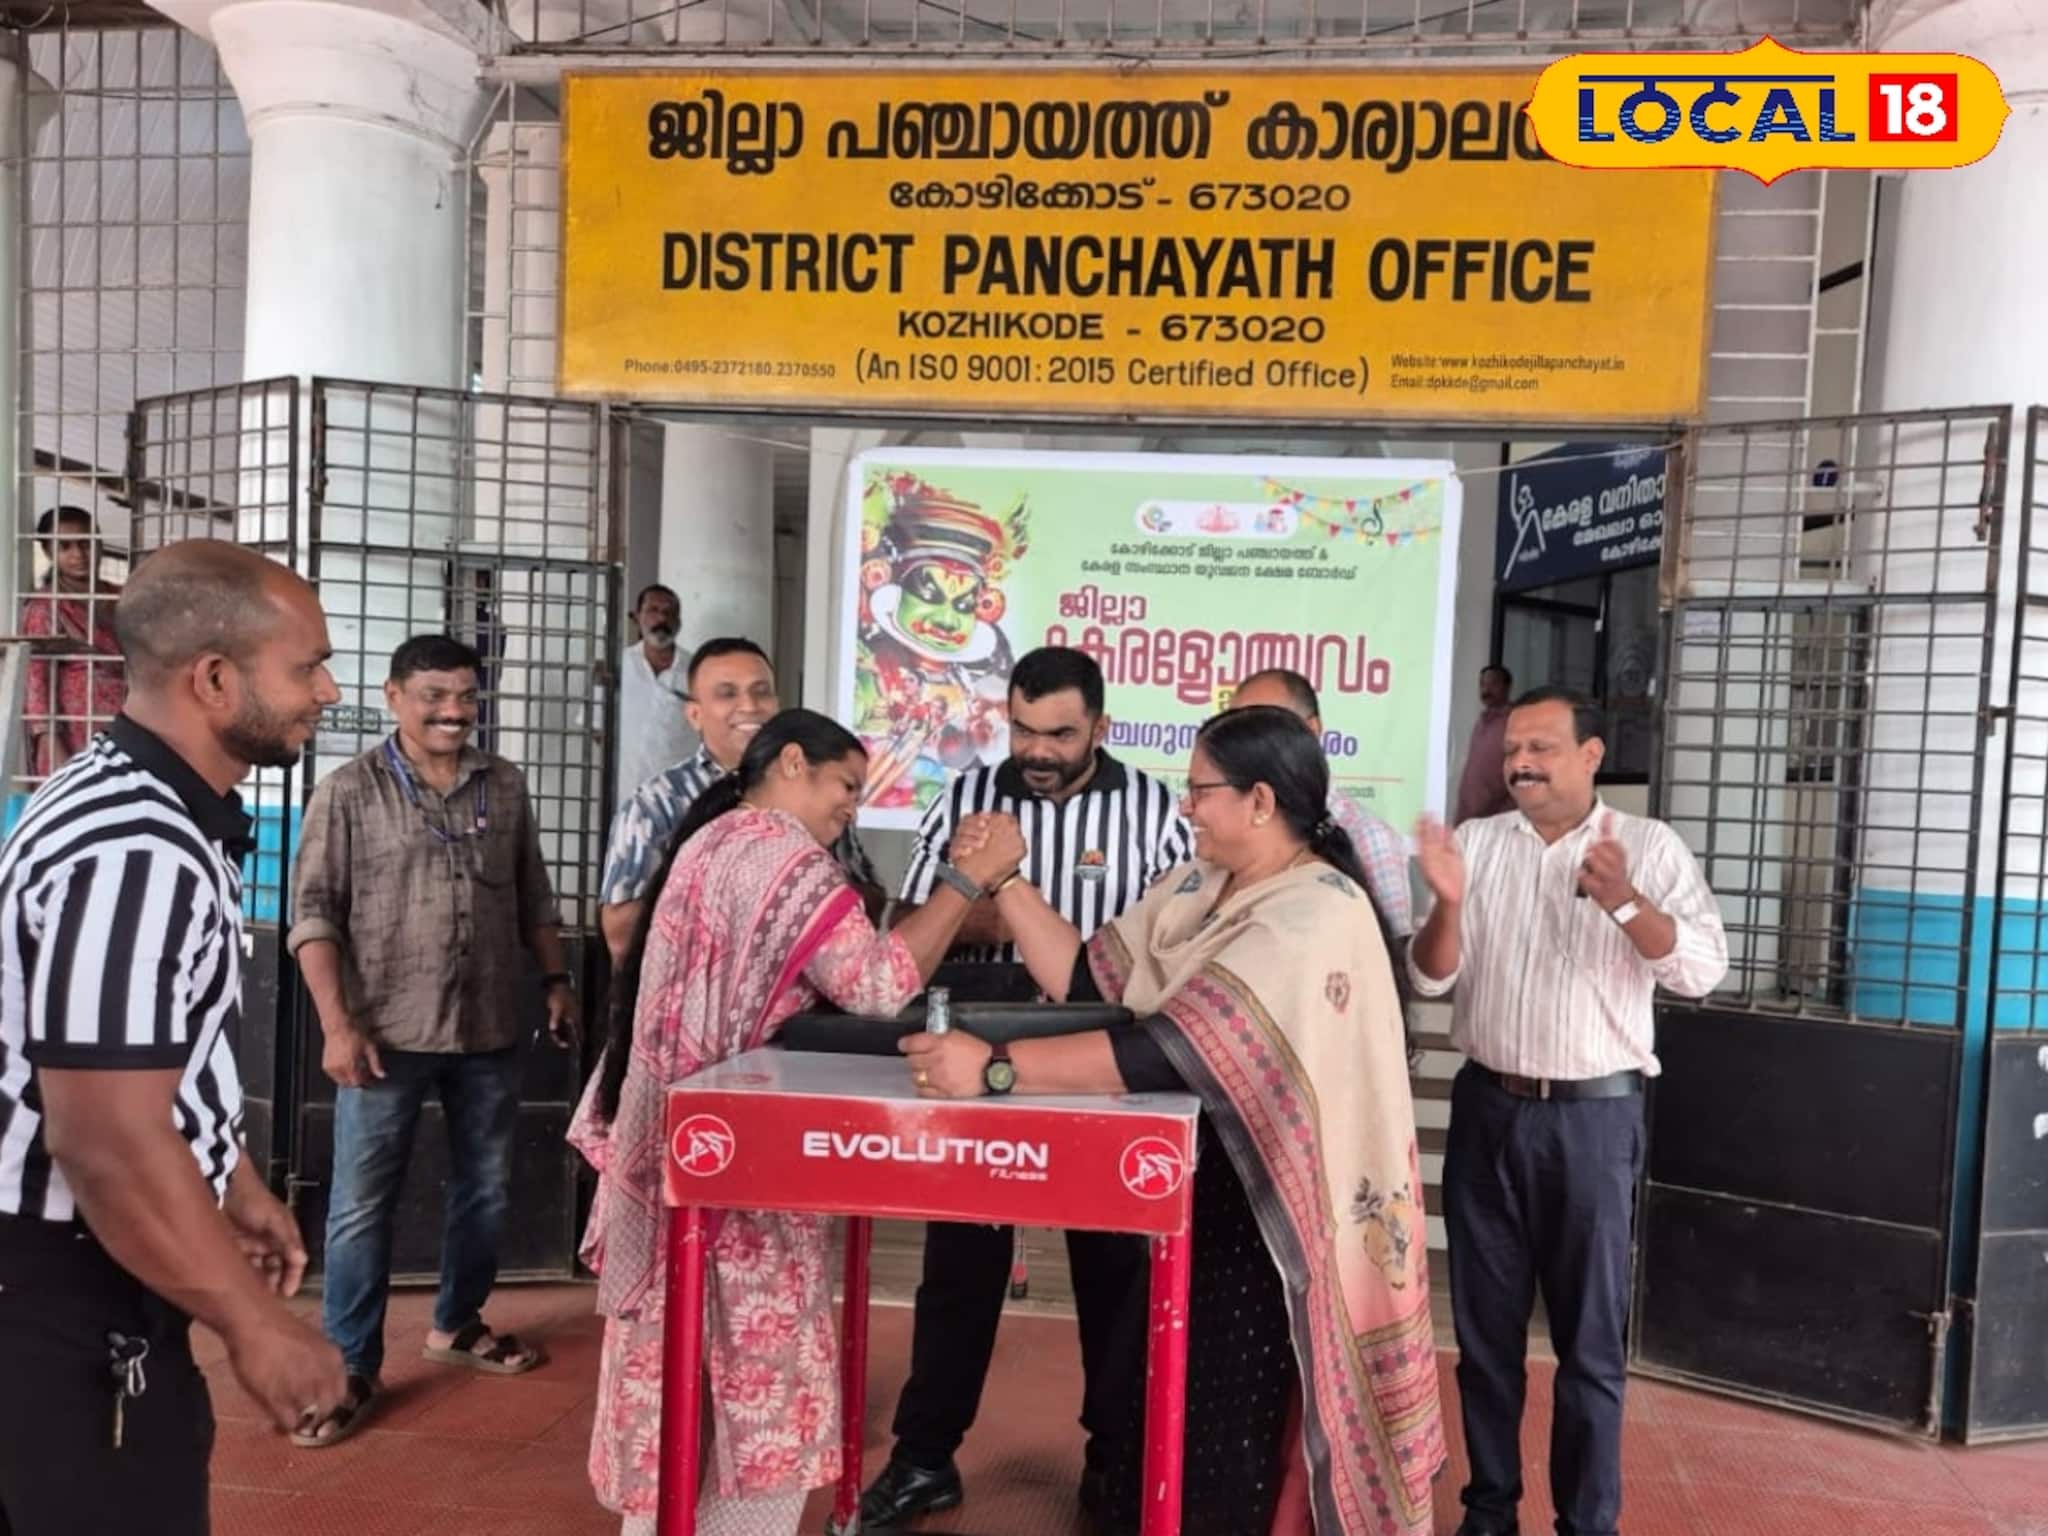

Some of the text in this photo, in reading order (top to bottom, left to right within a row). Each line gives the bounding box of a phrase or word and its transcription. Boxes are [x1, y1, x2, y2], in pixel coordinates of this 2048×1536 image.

[648, 89, 1558, 175] ജില്ലാ പഞ്ചായത്ത് കാര്യാല
[889, 174, 1155, 210] കോഴിക്കോട്
[1189, 182, 1351, 212] 673020
[662, 232, 1596, 304] DISTRICT PANCHAYATH OFFICE
[898, 310, 1104, 341] KOZHIKODE
[1160, 314, 1326, 343] 673020
[855, 348, 900, 384] (An
[909, 354, 958, 380] ISO
[1127, 358, 1253, 387] Certified
[1265, 356, 1370, 395] Office)
[1541, 495, 1593, 532] കേരള
[1081, 559, 1122, 576] കേരള
[1110, 542, 1196, 557] കോഴിക്കോട്
[1198, 542, 1234, 562] ജില്ലാ
[1236, 545, 1318, 561] പഞ്ചായത്ത്
[1058, 584, 1147, 626] ജില്ലാ
[802, 1129, 1048, 1169] EVOLUTION
